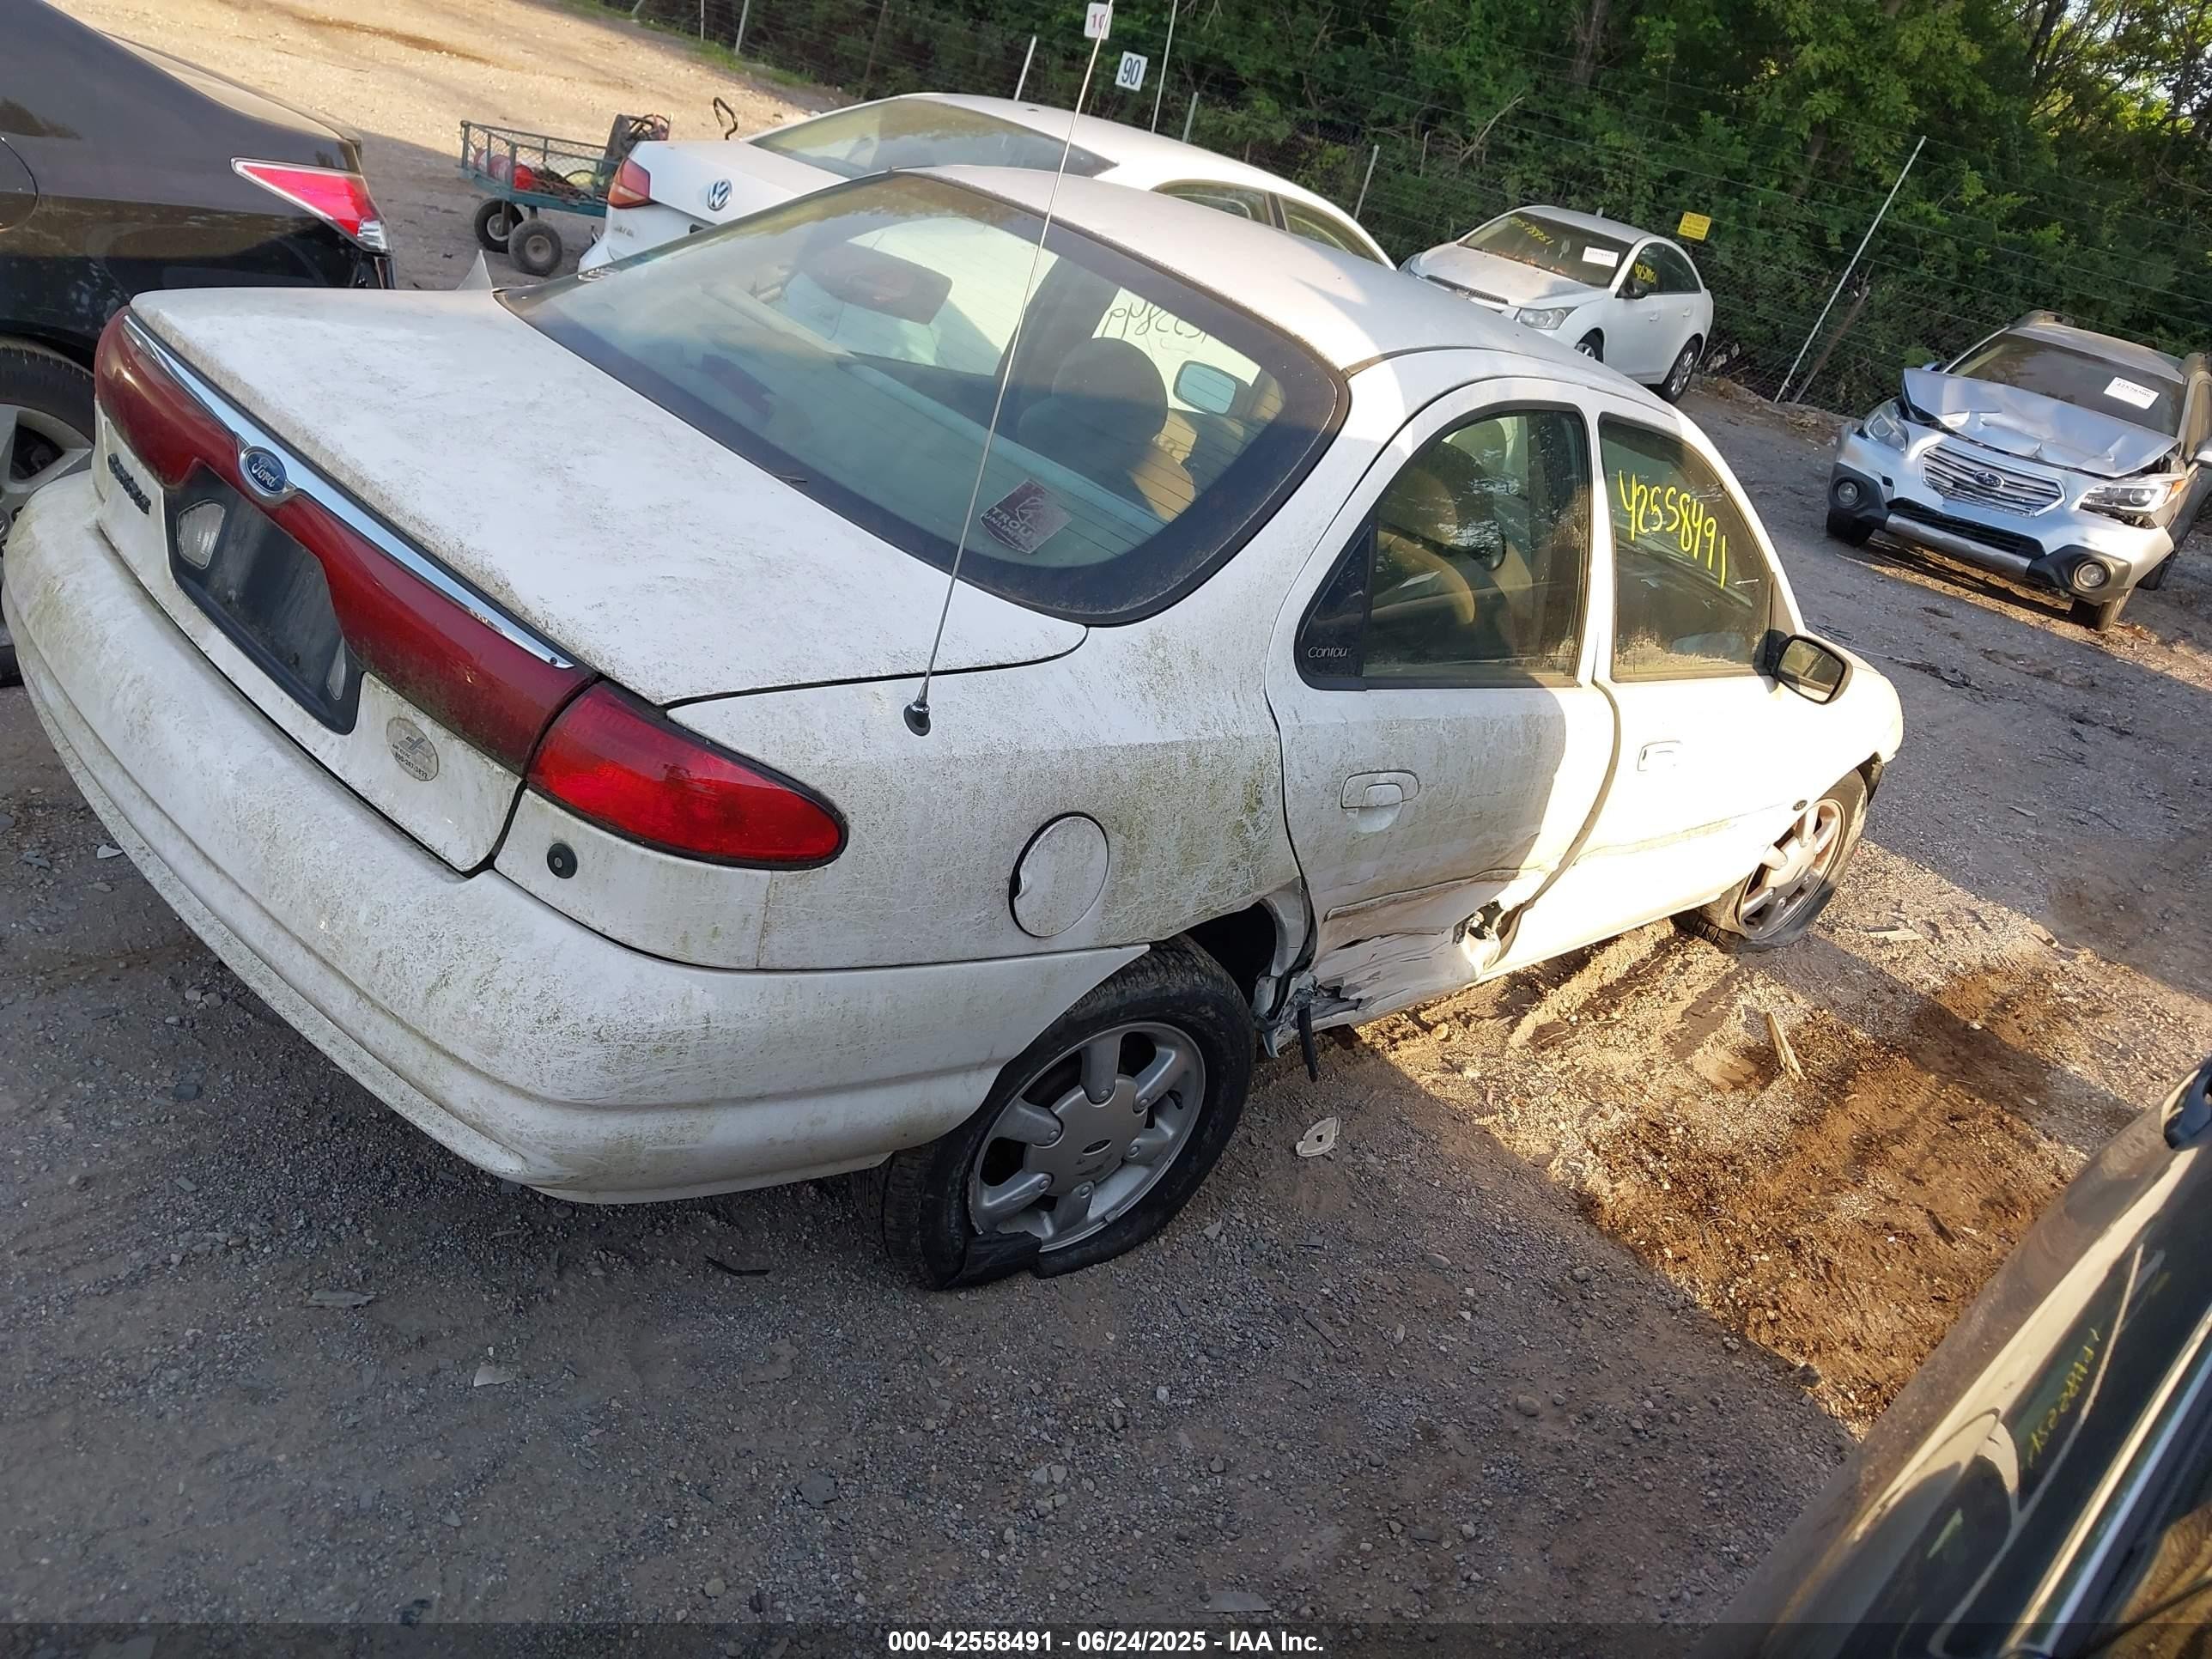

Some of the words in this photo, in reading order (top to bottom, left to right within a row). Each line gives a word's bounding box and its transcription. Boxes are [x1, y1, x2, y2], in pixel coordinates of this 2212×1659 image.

[1121, 57, 1141, 86] 90
[251, 459, 276, 489] Ford
[992, 507, 1033, 538] TROU
[1619, 469, 1727, 590] 42558491
